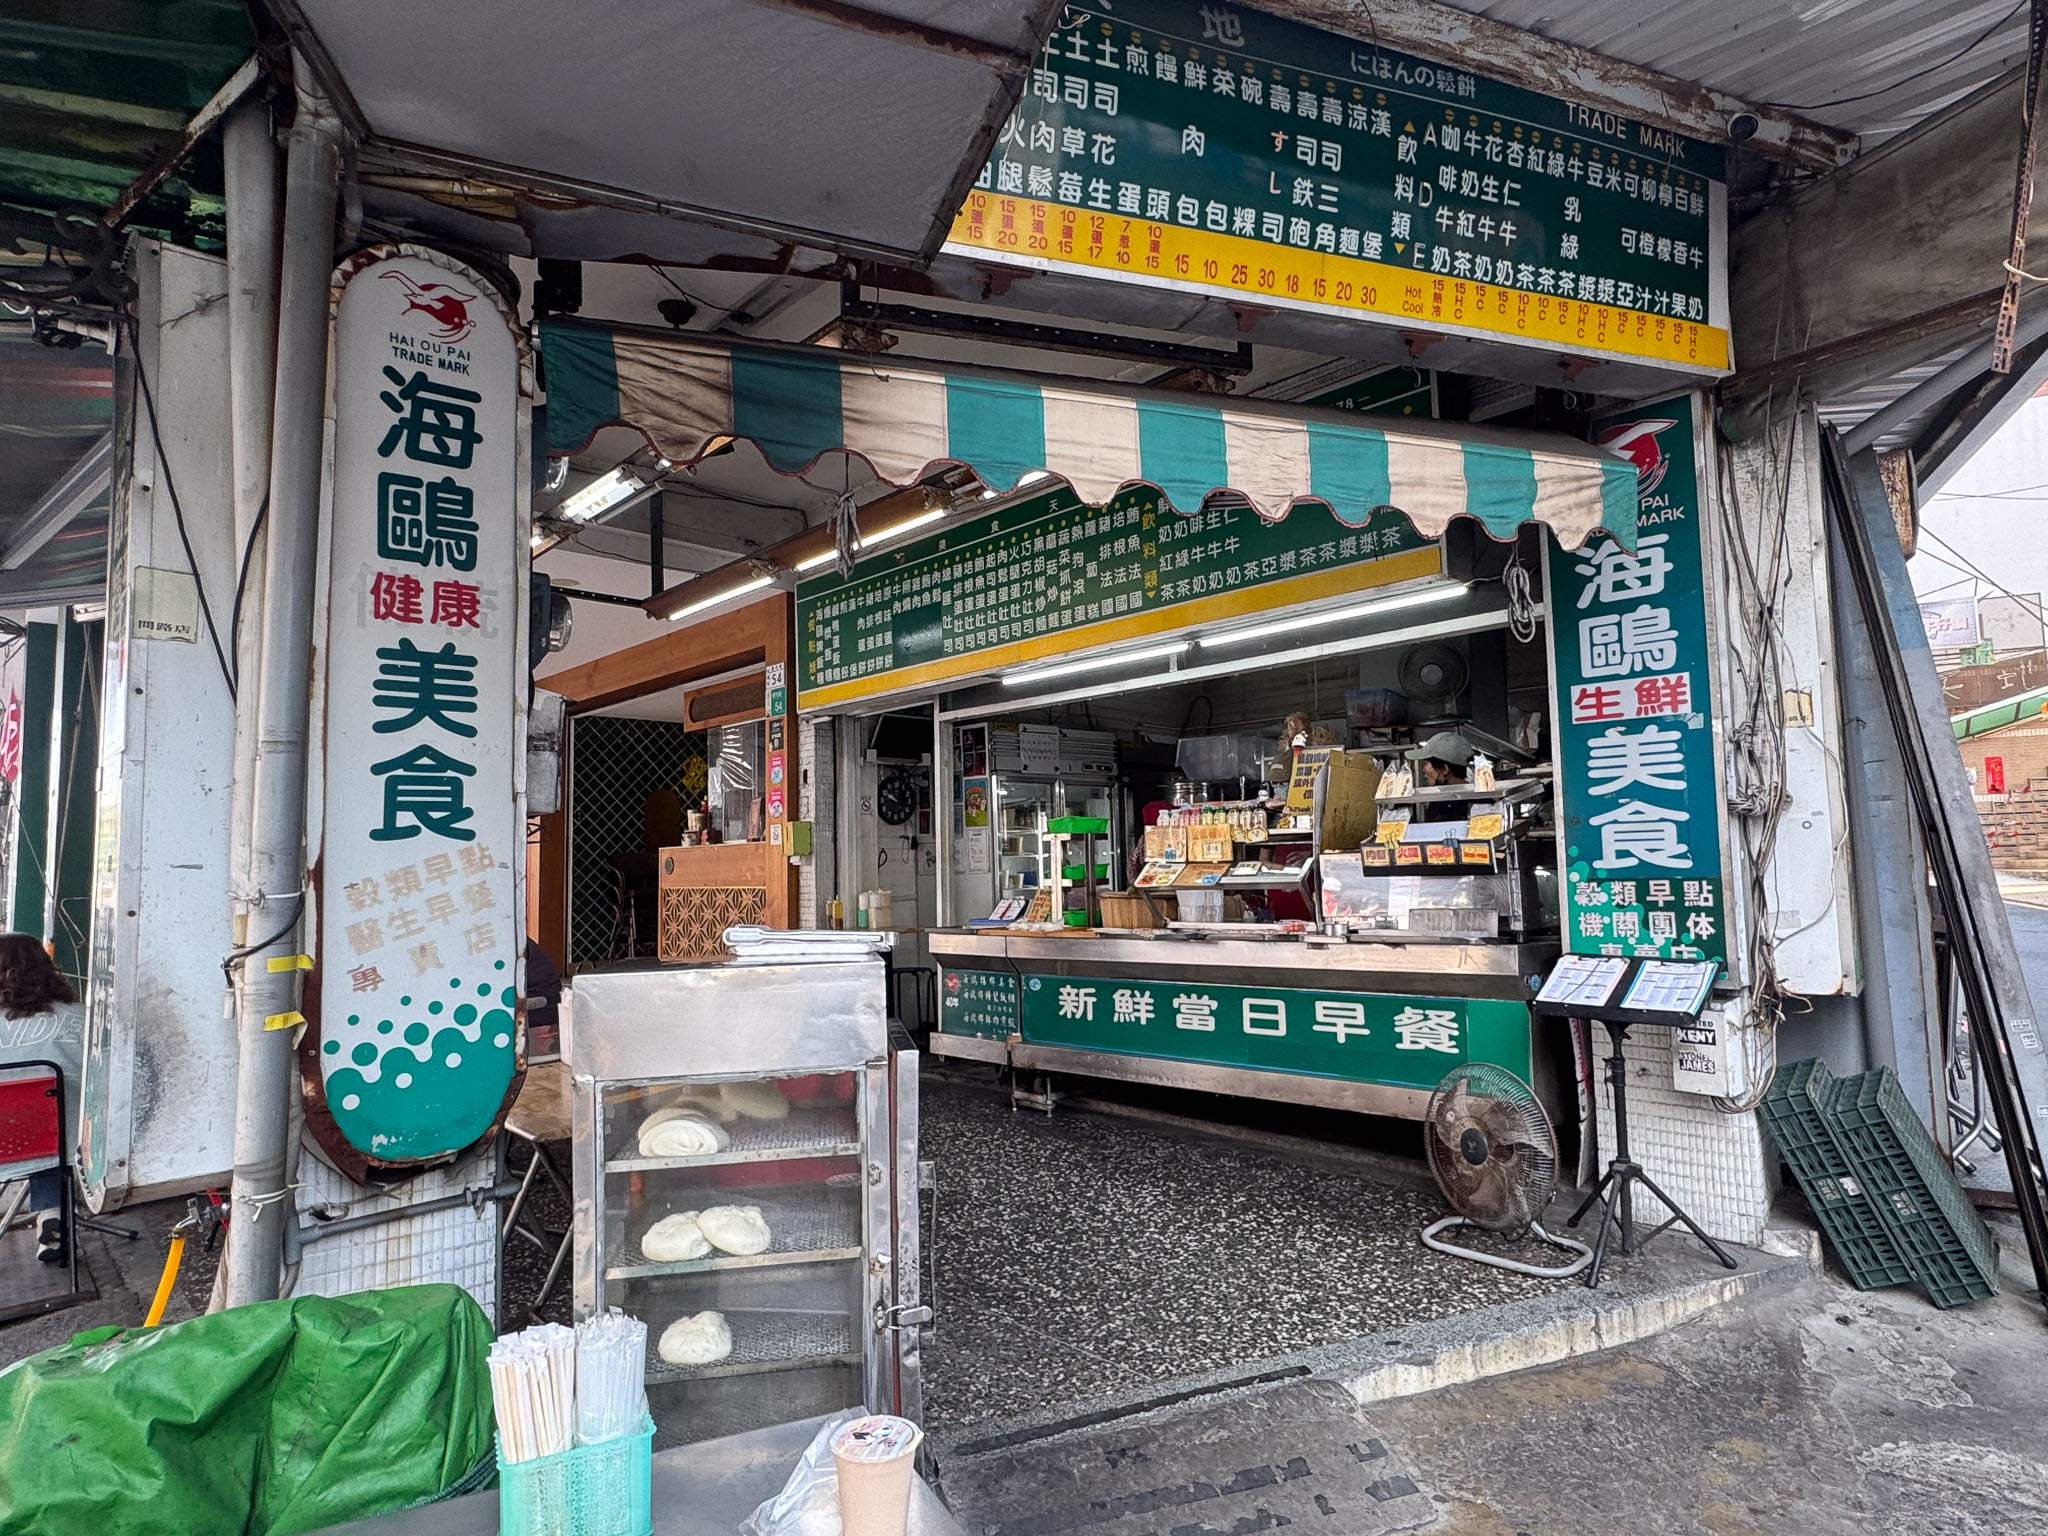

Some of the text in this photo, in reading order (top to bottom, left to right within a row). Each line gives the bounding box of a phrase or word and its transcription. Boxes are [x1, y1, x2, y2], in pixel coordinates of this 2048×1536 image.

[1566, 103, 1686, 159] TRADE MARK
[1174, 254, 1190, 275] 15
[1203, 259, 1218, 279] 10
[1231, 264, 1248, 285] 25
[1257, 269, 1275, 289] 30
[1286, 274, 1299, 294] 18
[1313, 278, 1327, 298] 15
[1336, 281, 1353, 301] 20
[1360, 286, 1377, 306] 30
[1405, 285, 1422, 299] Hot
[1402, 300, 1423, 314] Cool
[390, 332, 471, 362] HAI OU PAI
[392, 346, 470, 376] TRADE MARK
[1641, 493, 1669, 511] PAI
[370, 571, 482, 628] 健康
[771, 672, 783, 686] 54
[774, 700, 783, 713] 54
[1574, 677, 1688, 723] 生鮮
[369, 637, 479, 843] 美食
[1587, 724, 1693, 869] 美食
[1576, 879, 1714, 908] 穀類早點
[1057, 984, 1460, 1054] 新鮮當日早餐
[1681, 1060, 1715, 1073] JAMES
